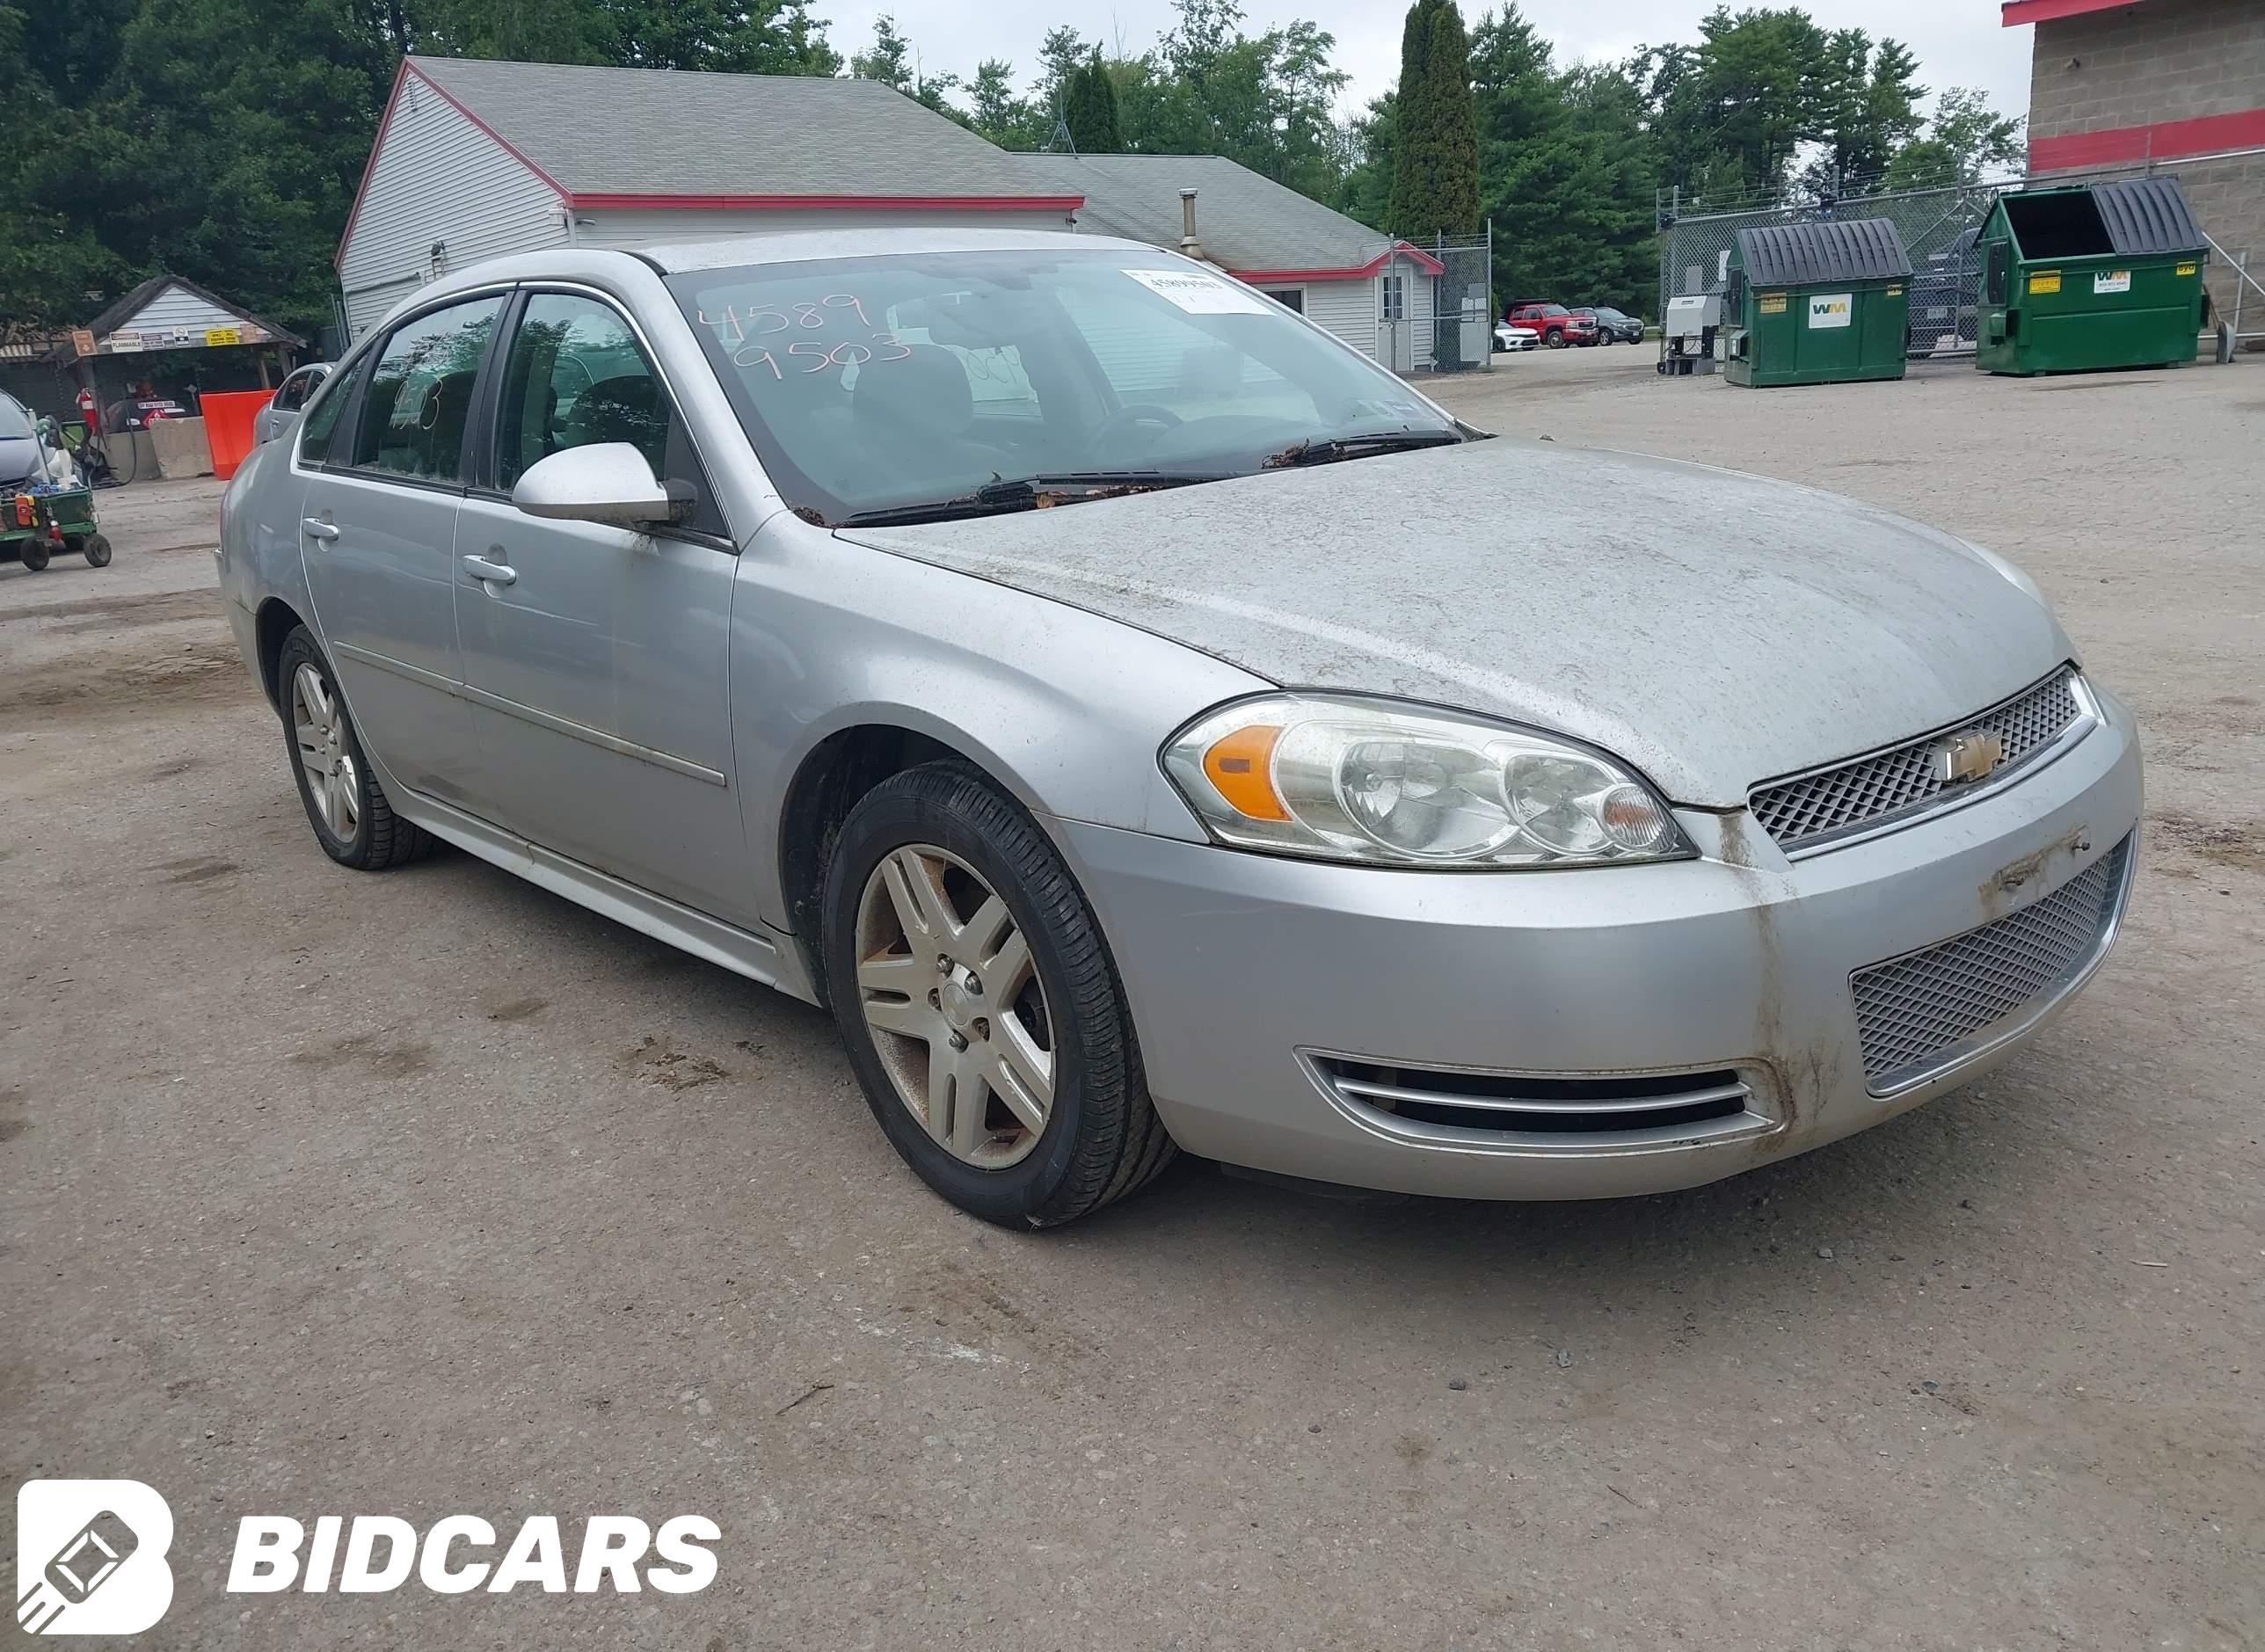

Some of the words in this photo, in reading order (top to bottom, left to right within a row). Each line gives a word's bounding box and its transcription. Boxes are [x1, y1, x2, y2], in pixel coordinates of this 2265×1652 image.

[697, 294, 871, 342] 4589
[1813, 302, 1846, 314] WM
[733, 333, 912, 380] 9503
